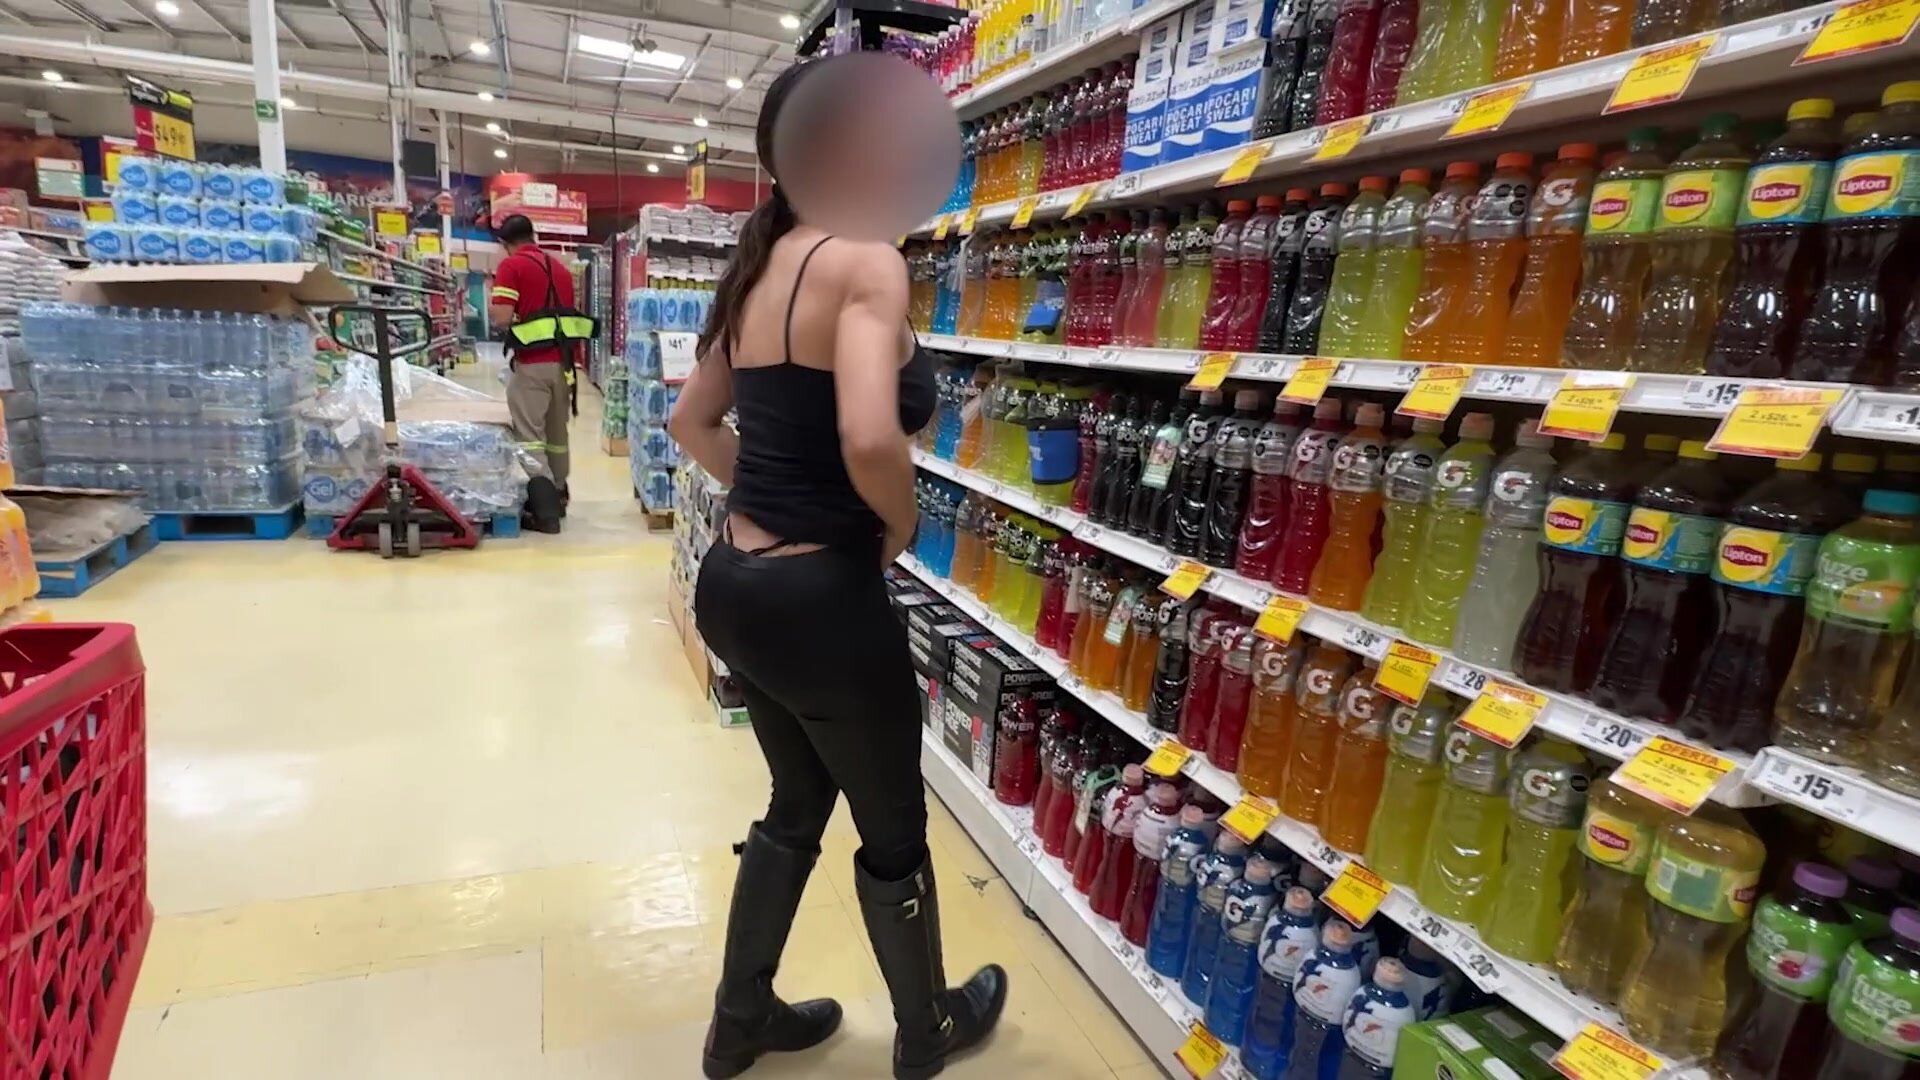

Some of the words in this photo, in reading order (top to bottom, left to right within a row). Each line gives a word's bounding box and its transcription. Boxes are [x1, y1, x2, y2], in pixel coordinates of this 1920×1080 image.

[1207, 86, 1257, 111] POCARI
[1126, 115, 1163, 135] POCARI
[1167, 101, 1208, 125] POCARI
[1205, 102, 1249, 124] SWEAT
[1124, 131, 1157, 147] SWEAT
[1164, 117, 1201, 137] SWEAT
[1542, 178, 1579, 206] G
[1667, 191, 1706, 205] Lipton
[1753, 186, 1797, 201] Lipton
[1841, 178, 1888, 194] Lipton
[1592, 200, 1623, 213] Lipton
[1706, 383, 1741, 404] $15
[1895, 406, 1920, 430] $1
[1188, 420, 1209, 443] G
[1437, 460, 1473, 487] G
[1493, 471, 1533, 501] G
[1724, 546, 1764, 565] Lipton
[1821, 552, 1868, 582] fuze
[1158, 600, 1175, 624] G
[1262, 652, 1287, 676] G
[1307, 668, 1333, 694] G
[1462, 670, 1487, 691] $28
[1347, 688, 1375, 719] G
[1391, 705, 1418, 735] G
[1445, 731, 1471, 763] G
[1602, 724, 1632, 748] $20
[1660, 742, 1719, 766] OFERTA
[1522, 768, 1557, 798] G
[1793, 774, 1832, 801] $15
[1591, 827, 1627, 848] Lipton
[1224, 895, 1247, 923] G
[1420, 916, 1442, 938] $20
[1852, 974, 1912, 1014] fuze
